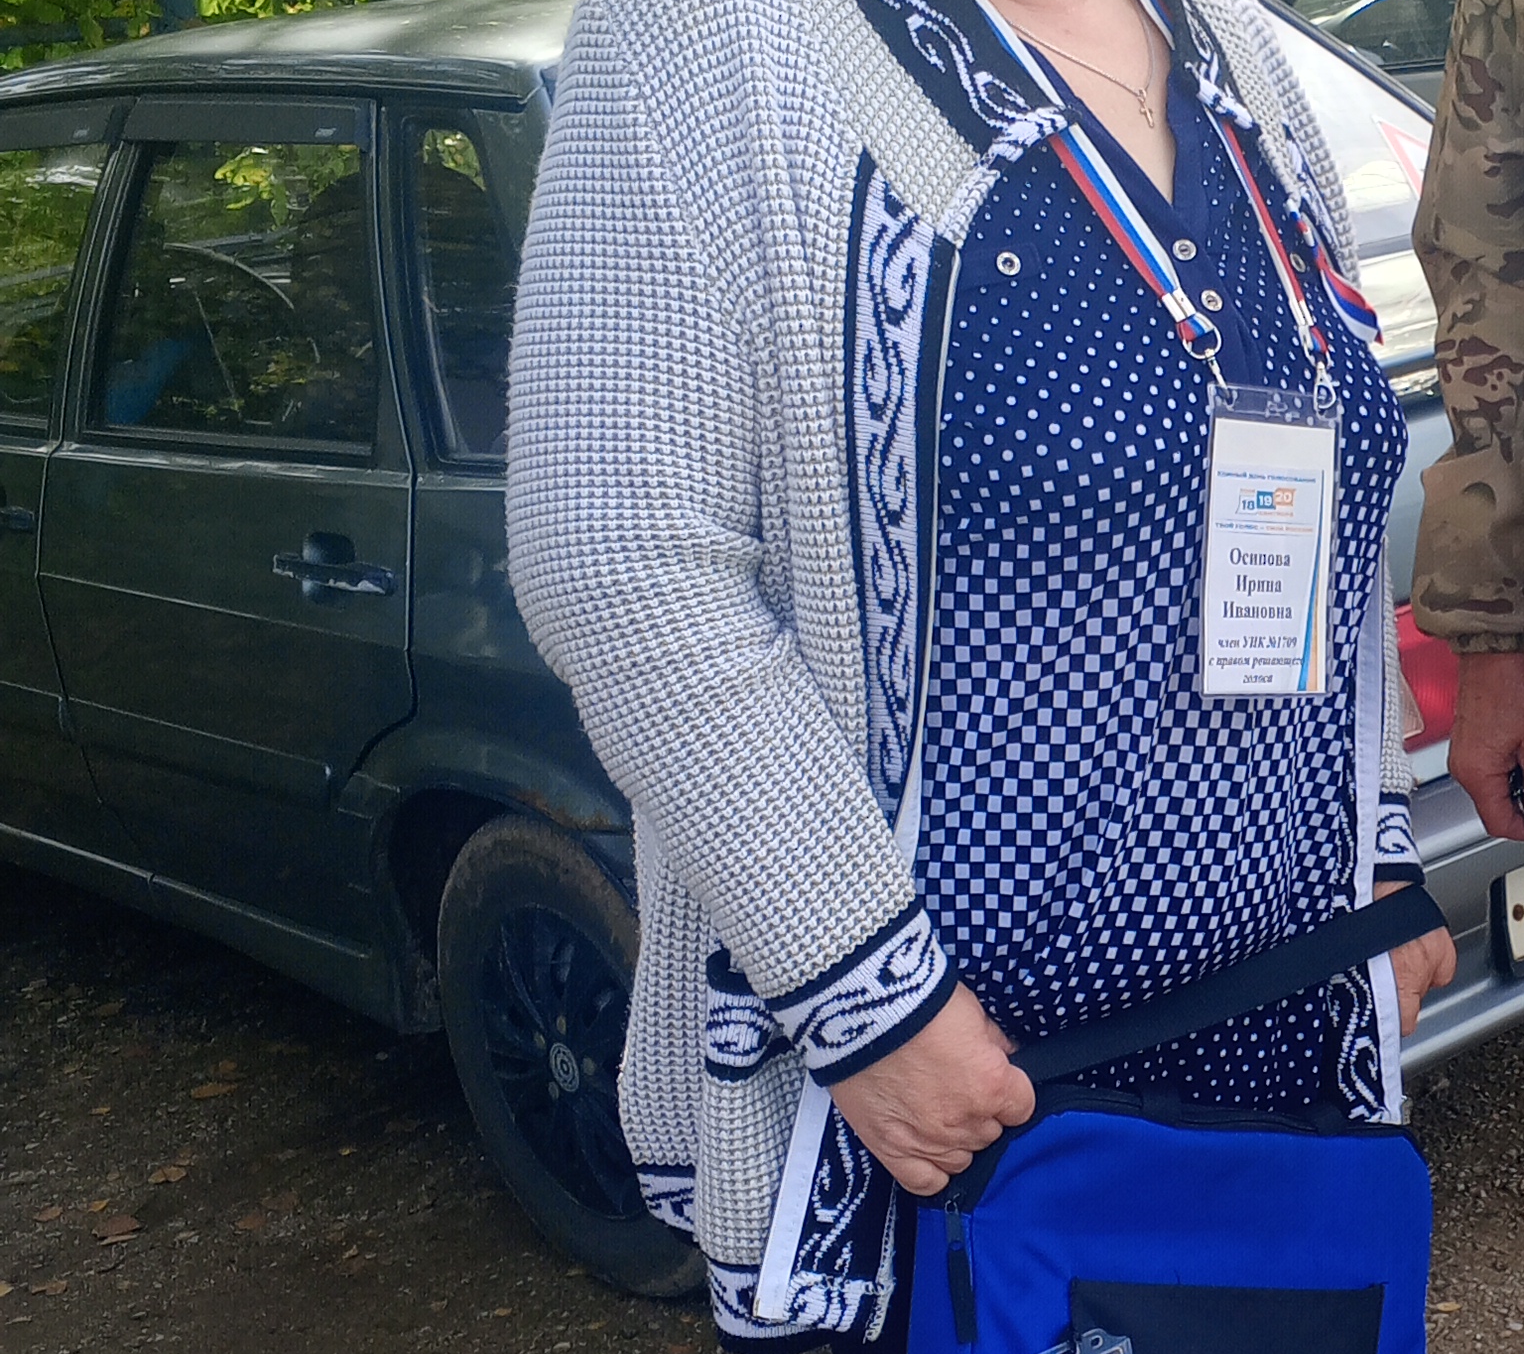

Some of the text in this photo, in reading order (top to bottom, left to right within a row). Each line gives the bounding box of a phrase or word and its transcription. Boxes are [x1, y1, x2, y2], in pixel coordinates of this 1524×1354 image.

[1229, 547, 1291, 567] Осипова
[1235, 574, 1282, 597] Ирина
[1222, 601, 1293, 620] Ивановна
